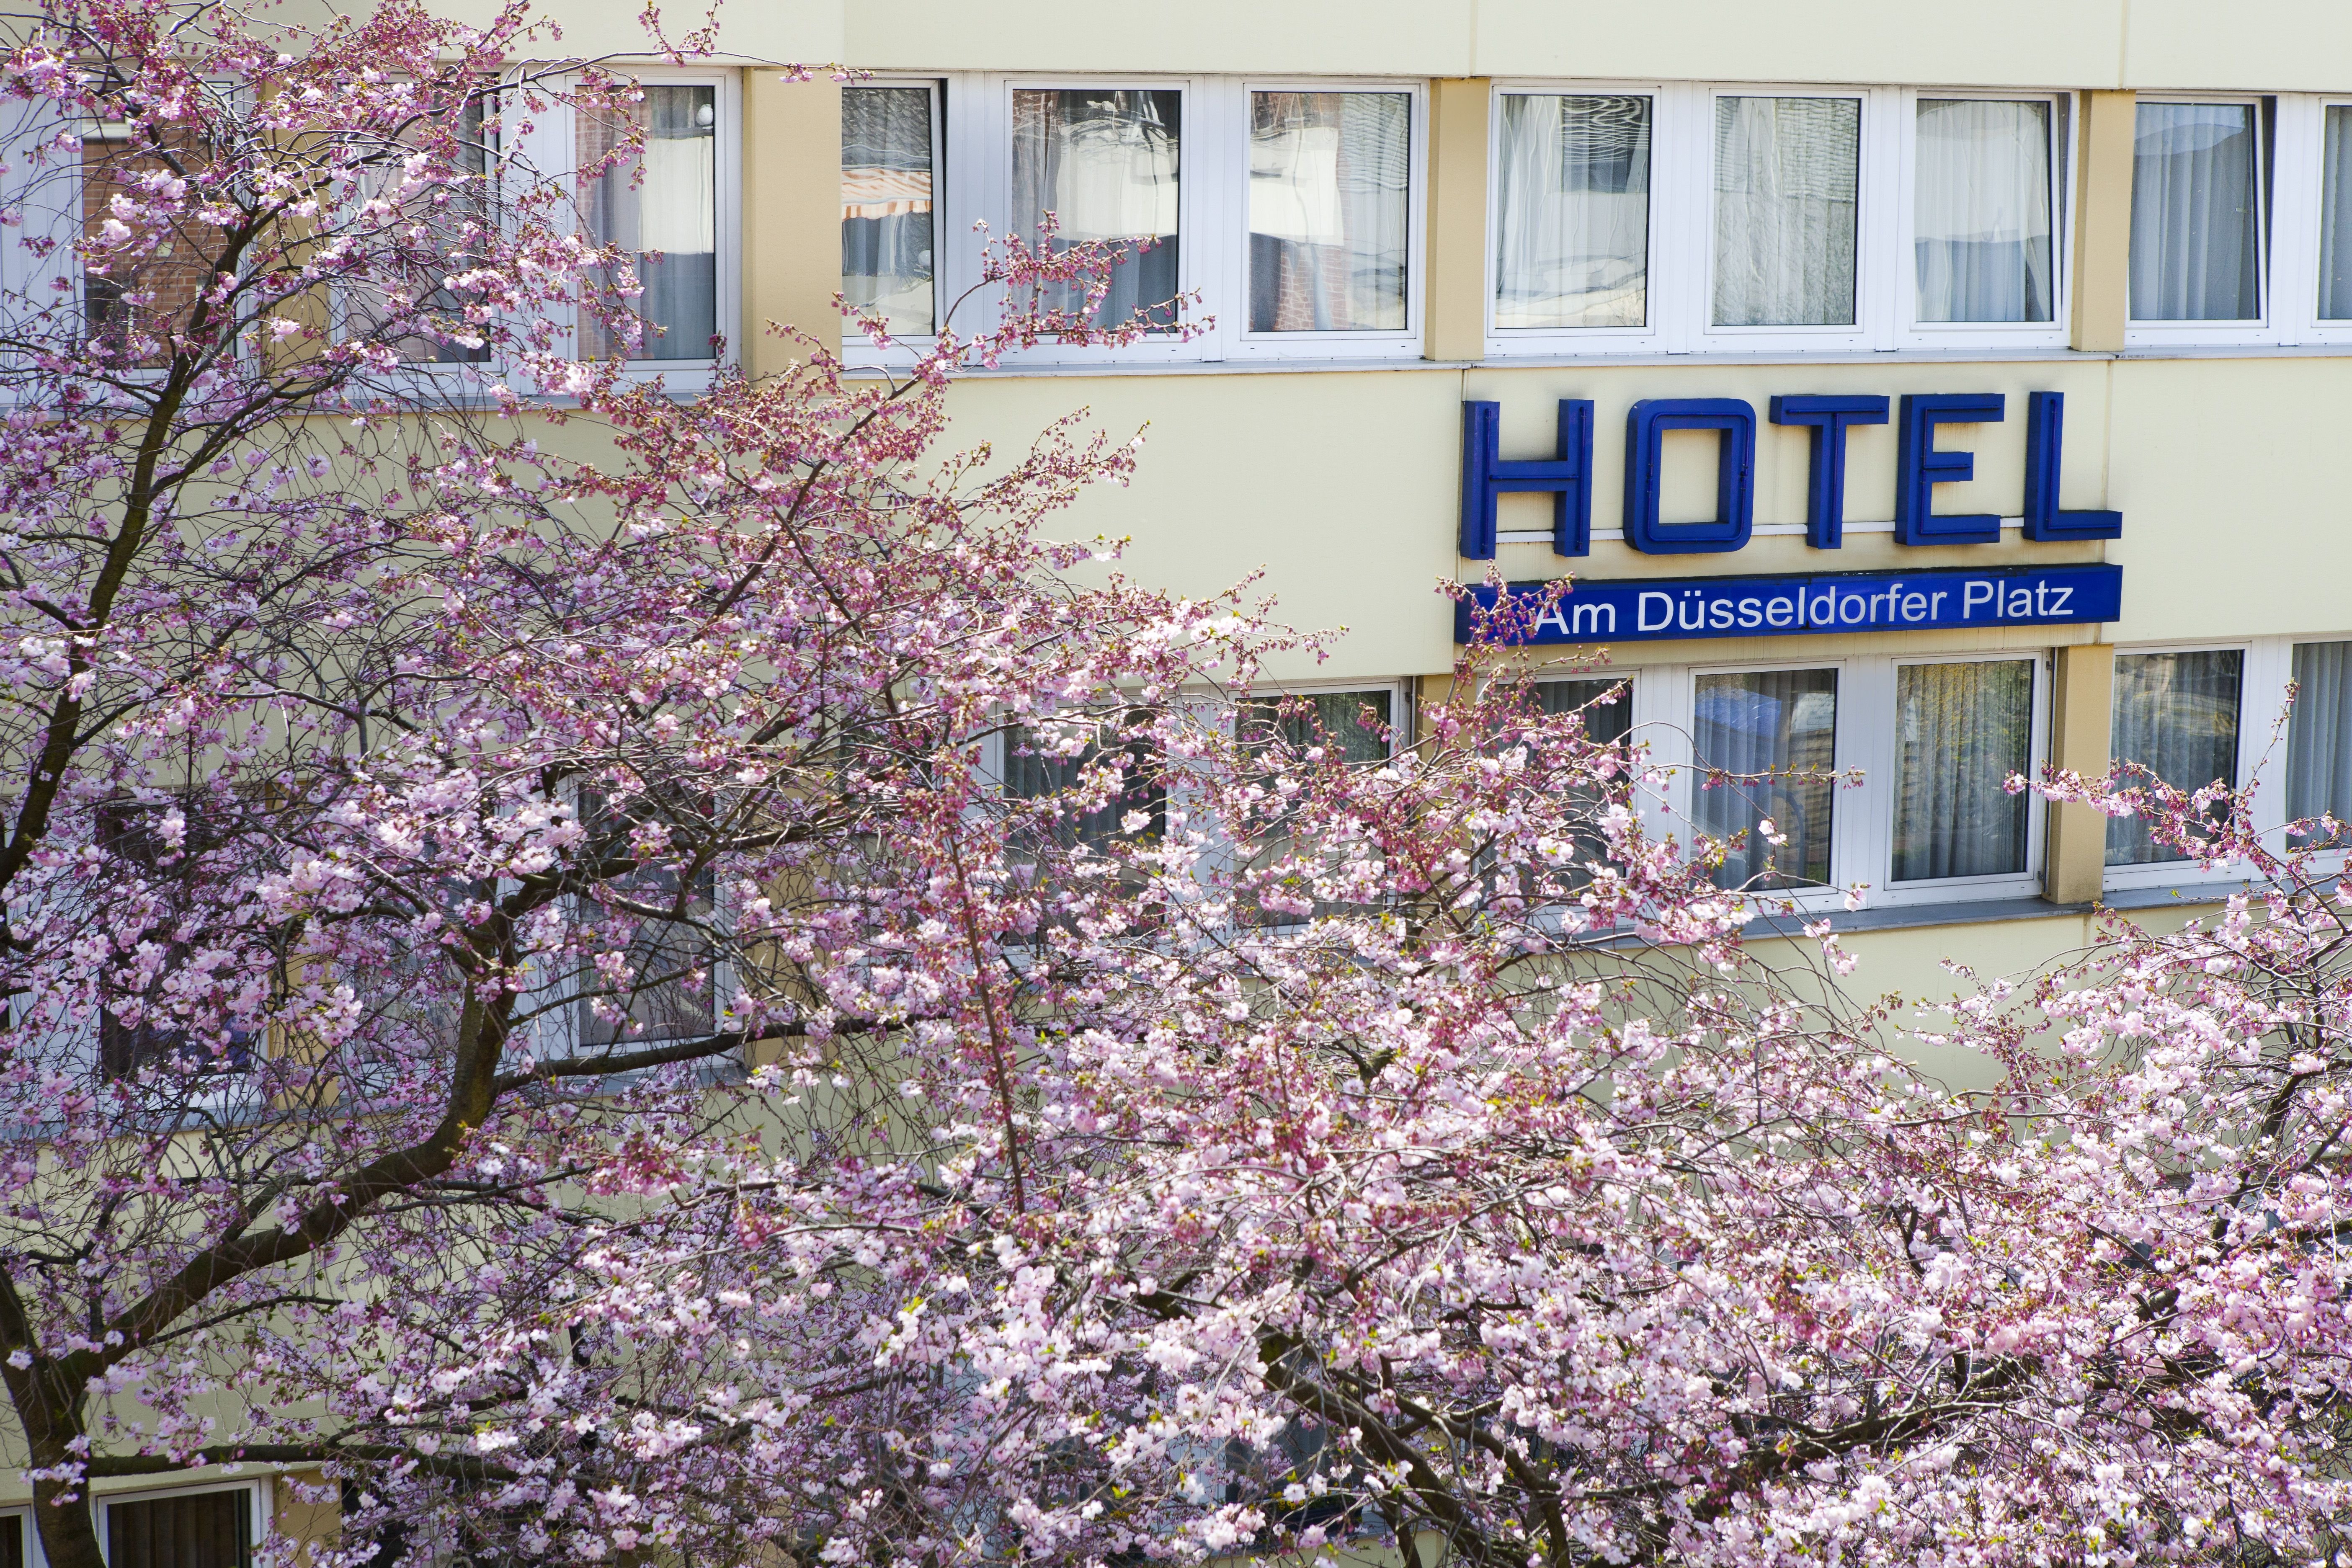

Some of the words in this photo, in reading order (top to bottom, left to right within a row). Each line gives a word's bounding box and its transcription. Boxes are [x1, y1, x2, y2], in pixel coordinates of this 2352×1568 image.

[1460, 392, 2122, 560] HOTEL
[1534, 596, 1616, 634] Am
[1638, 583, 1947, 632] Düsseldorfer
[1963, 580, 2074, 619] Platz
